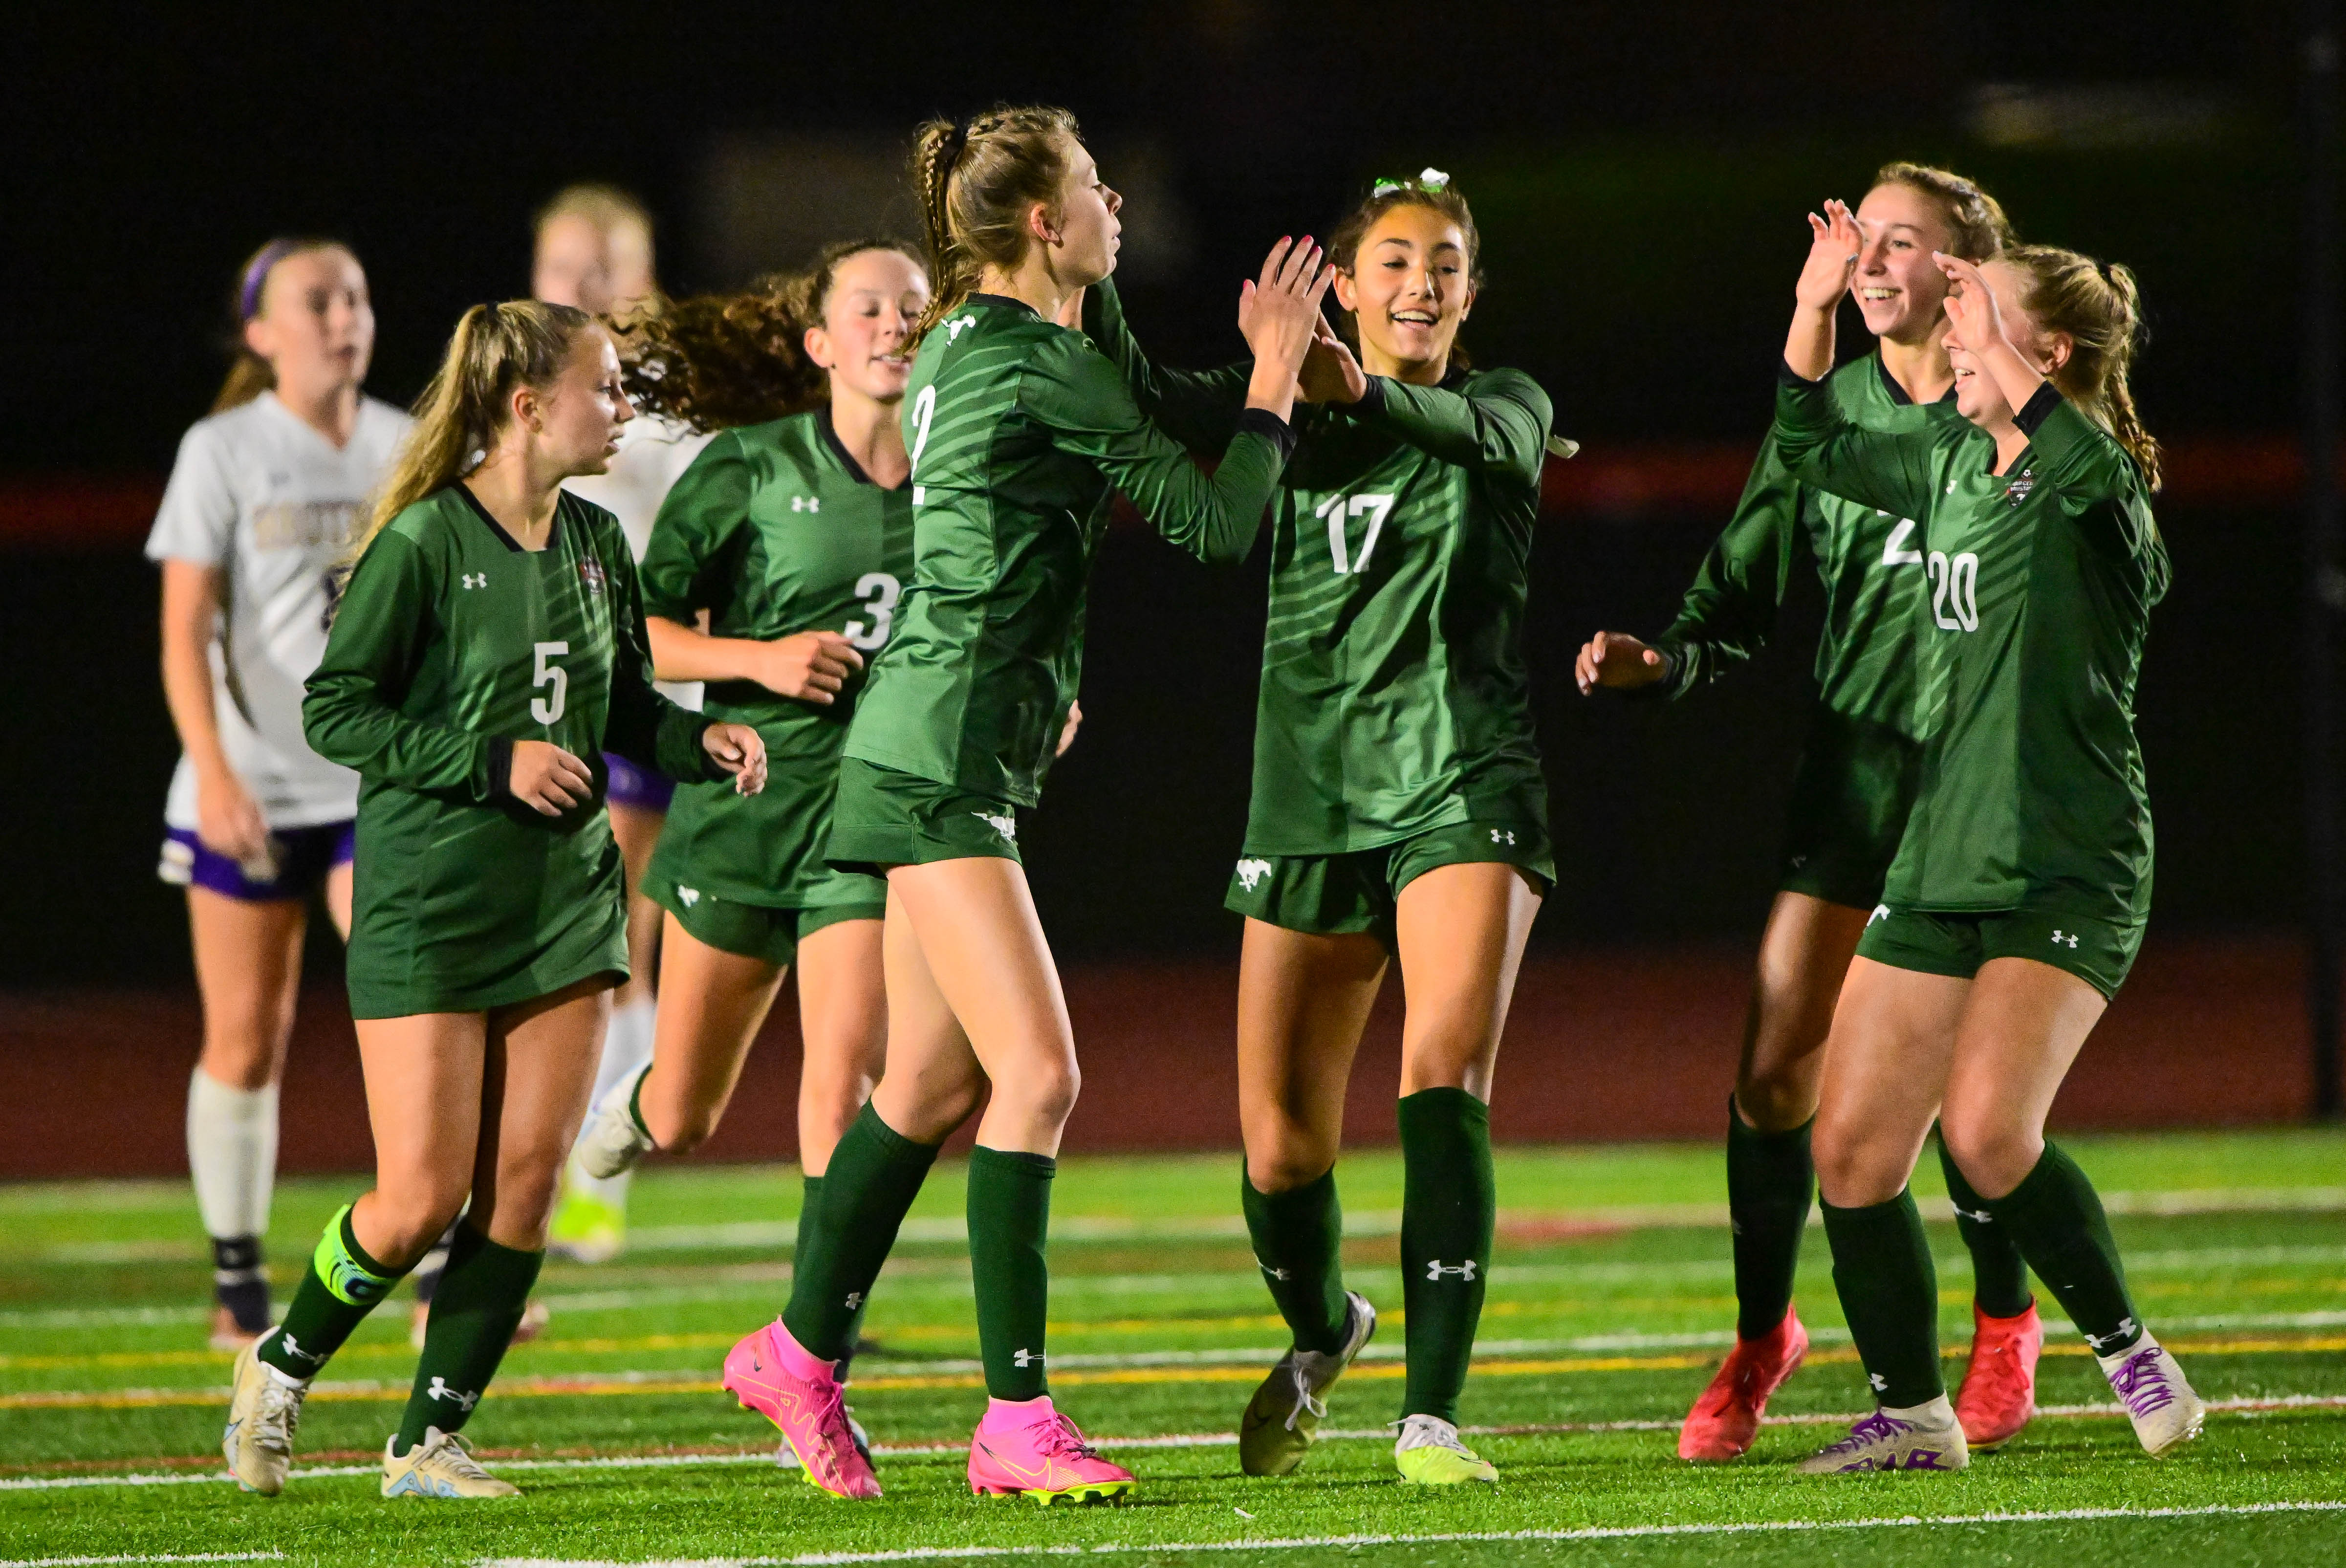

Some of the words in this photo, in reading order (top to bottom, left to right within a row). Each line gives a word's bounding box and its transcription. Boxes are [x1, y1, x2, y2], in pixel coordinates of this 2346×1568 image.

[1315, 493, 1394, 573] 17
[844, 572, 900, 650] 3
[1928, 550, 1979, 632] 20
[531, 641, 569, 725] 5
